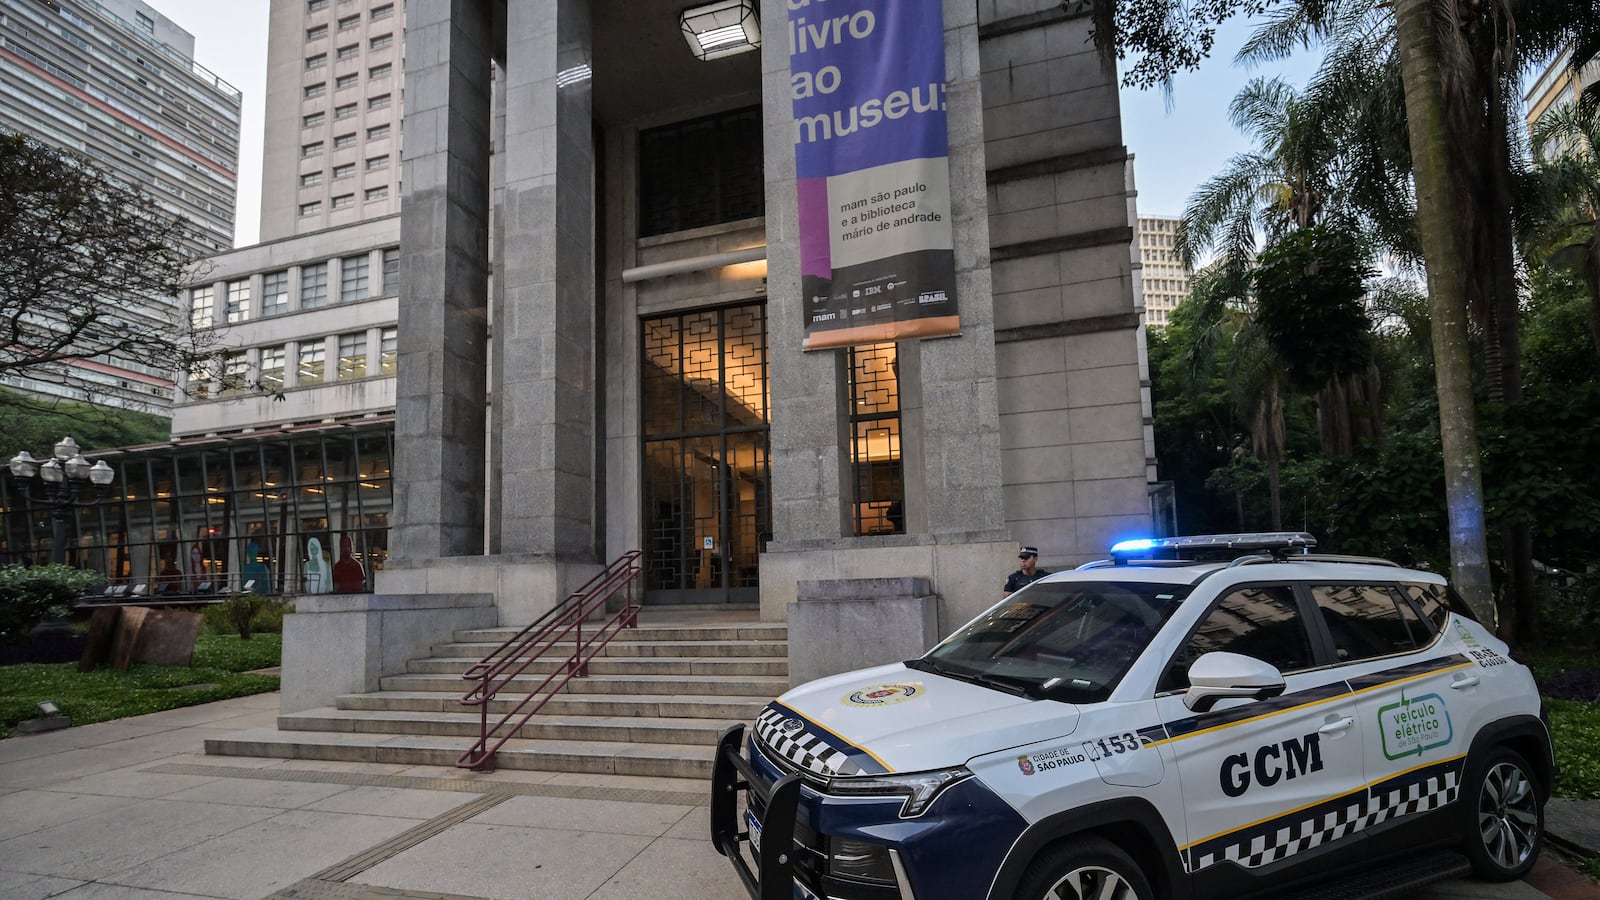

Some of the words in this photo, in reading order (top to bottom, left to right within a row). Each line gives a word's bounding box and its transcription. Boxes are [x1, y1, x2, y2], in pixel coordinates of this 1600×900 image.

[788, 9, 875, 55] livro
[791, 65, 842, 100] ao
[840, 198, 868, 213] mam
[870, 191, 891, 204] são
[893, 182, 927, 200] paulo
[841, 218, 848, 227] e
[851, 216, 858, 225] a
[860, 200, 916, 222] biblioteca
[842, 226, 873, 241] mário
[876, 221, 890, 232] de
[893, 211, 942, 228] andrade
[812, 312, 836, 323] mam
[1395, 719, 1439, 739] elétrico
[1032, 749, 1060, 763] CIDADE
[1060, 747, 1070, 756] DE
[1097, 732, 1139, 758] 153
[1037, 759, 1057, 772] SÃO
[1057, 754, 1085, 768] PAULO
[1220, 732, 1324, 798] GCM
